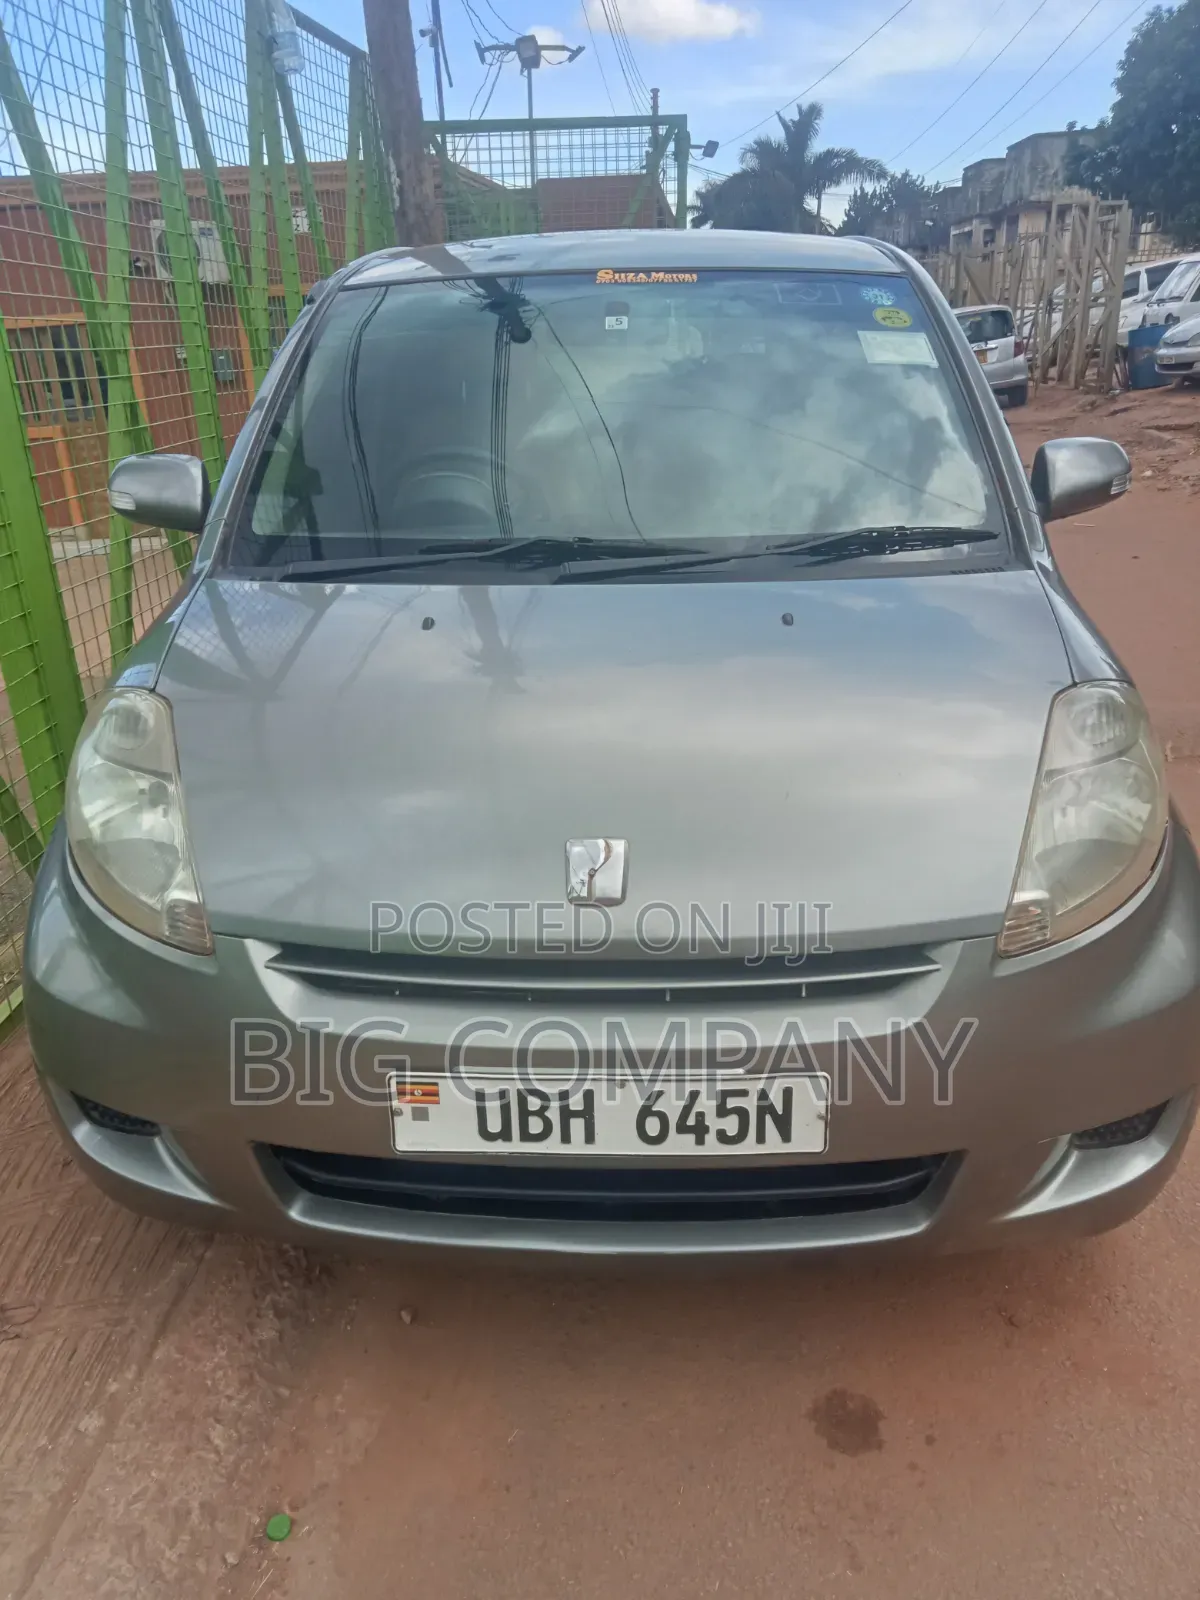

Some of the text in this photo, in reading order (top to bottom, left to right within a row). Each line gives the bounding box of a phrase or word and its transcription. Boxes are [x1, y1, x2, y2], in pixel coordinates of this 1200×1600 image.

[616, 317, 623, 325] 5
[475, 1086, 794, 1146] UBH 645N
